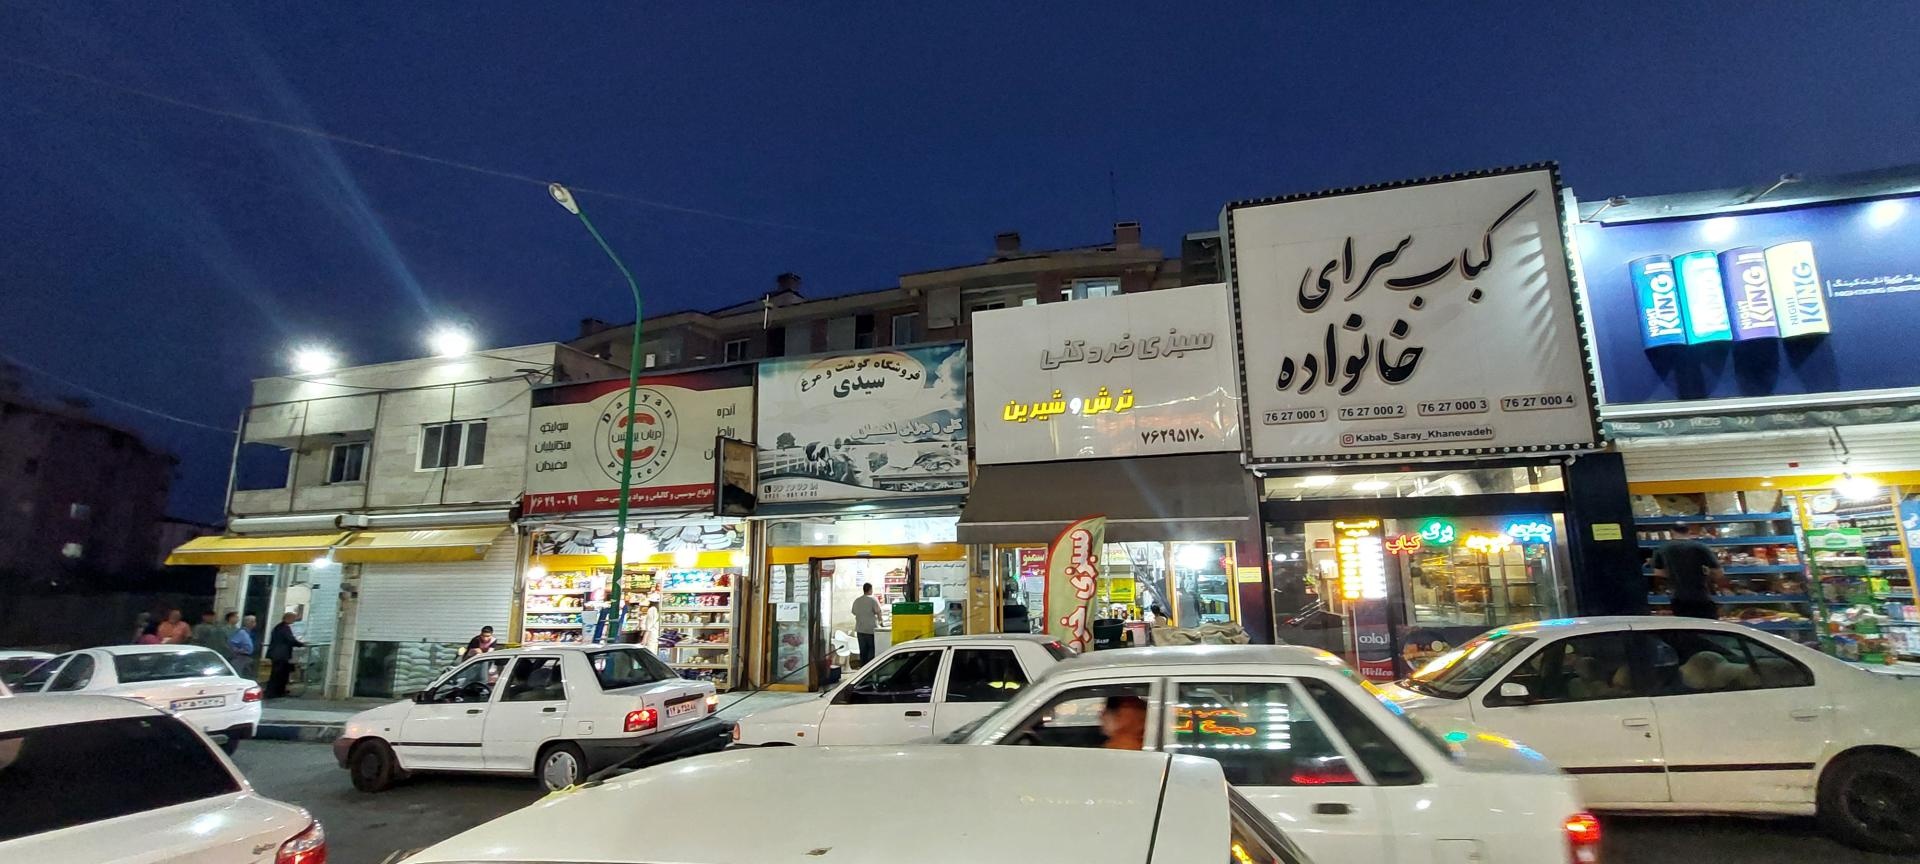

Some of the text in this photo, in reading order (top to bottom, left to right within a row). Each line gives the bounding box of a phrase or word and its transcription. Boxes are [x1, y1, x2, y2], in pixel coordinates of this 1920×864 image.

[1297, 188, 1538, 313] کباب سرای
[1650, 274, 1683, 336] KING
[1743, 266, 1776, 328] KING
[1790, 261, 1824, 326] NIGHT KING
[1040, 339, 1085, 371] کنی
[1138, 327, 1214, 360] سبزی
[1275, 312, 1425, 396] خانواده
[801, 358, 921, 393] فروشگاه گوشت و مرغ
[833, 374, 886, 398] سیدی
[602, 393, 673, 424] Dayan
[1003, 385, 1135, 424] ترش و شیرین
[1265, 411, 1278, 422] 76
[1280, 410, 1294, 421] 27
[1296, 409, 1316, 420] 000
[1340, 405, 1404, 418] 76 27 000 2
[1421, 400, 1488, 413] 76 27 000 3
[1505, 394, 1574, 409] 76 27 000 4
[539, 421, 569, 434] سولیکو
[1140, 428, 1205, 446] ۷۶۲۹۵۱۷۰
[1355, 426, 1493, 444] Kabab_Saray_Khanevadeh
[608, 449, 668, 479] Prtein
[1386, 534, 1422, 555] کباب
[1064, 528, 1099, 601] سبزی
